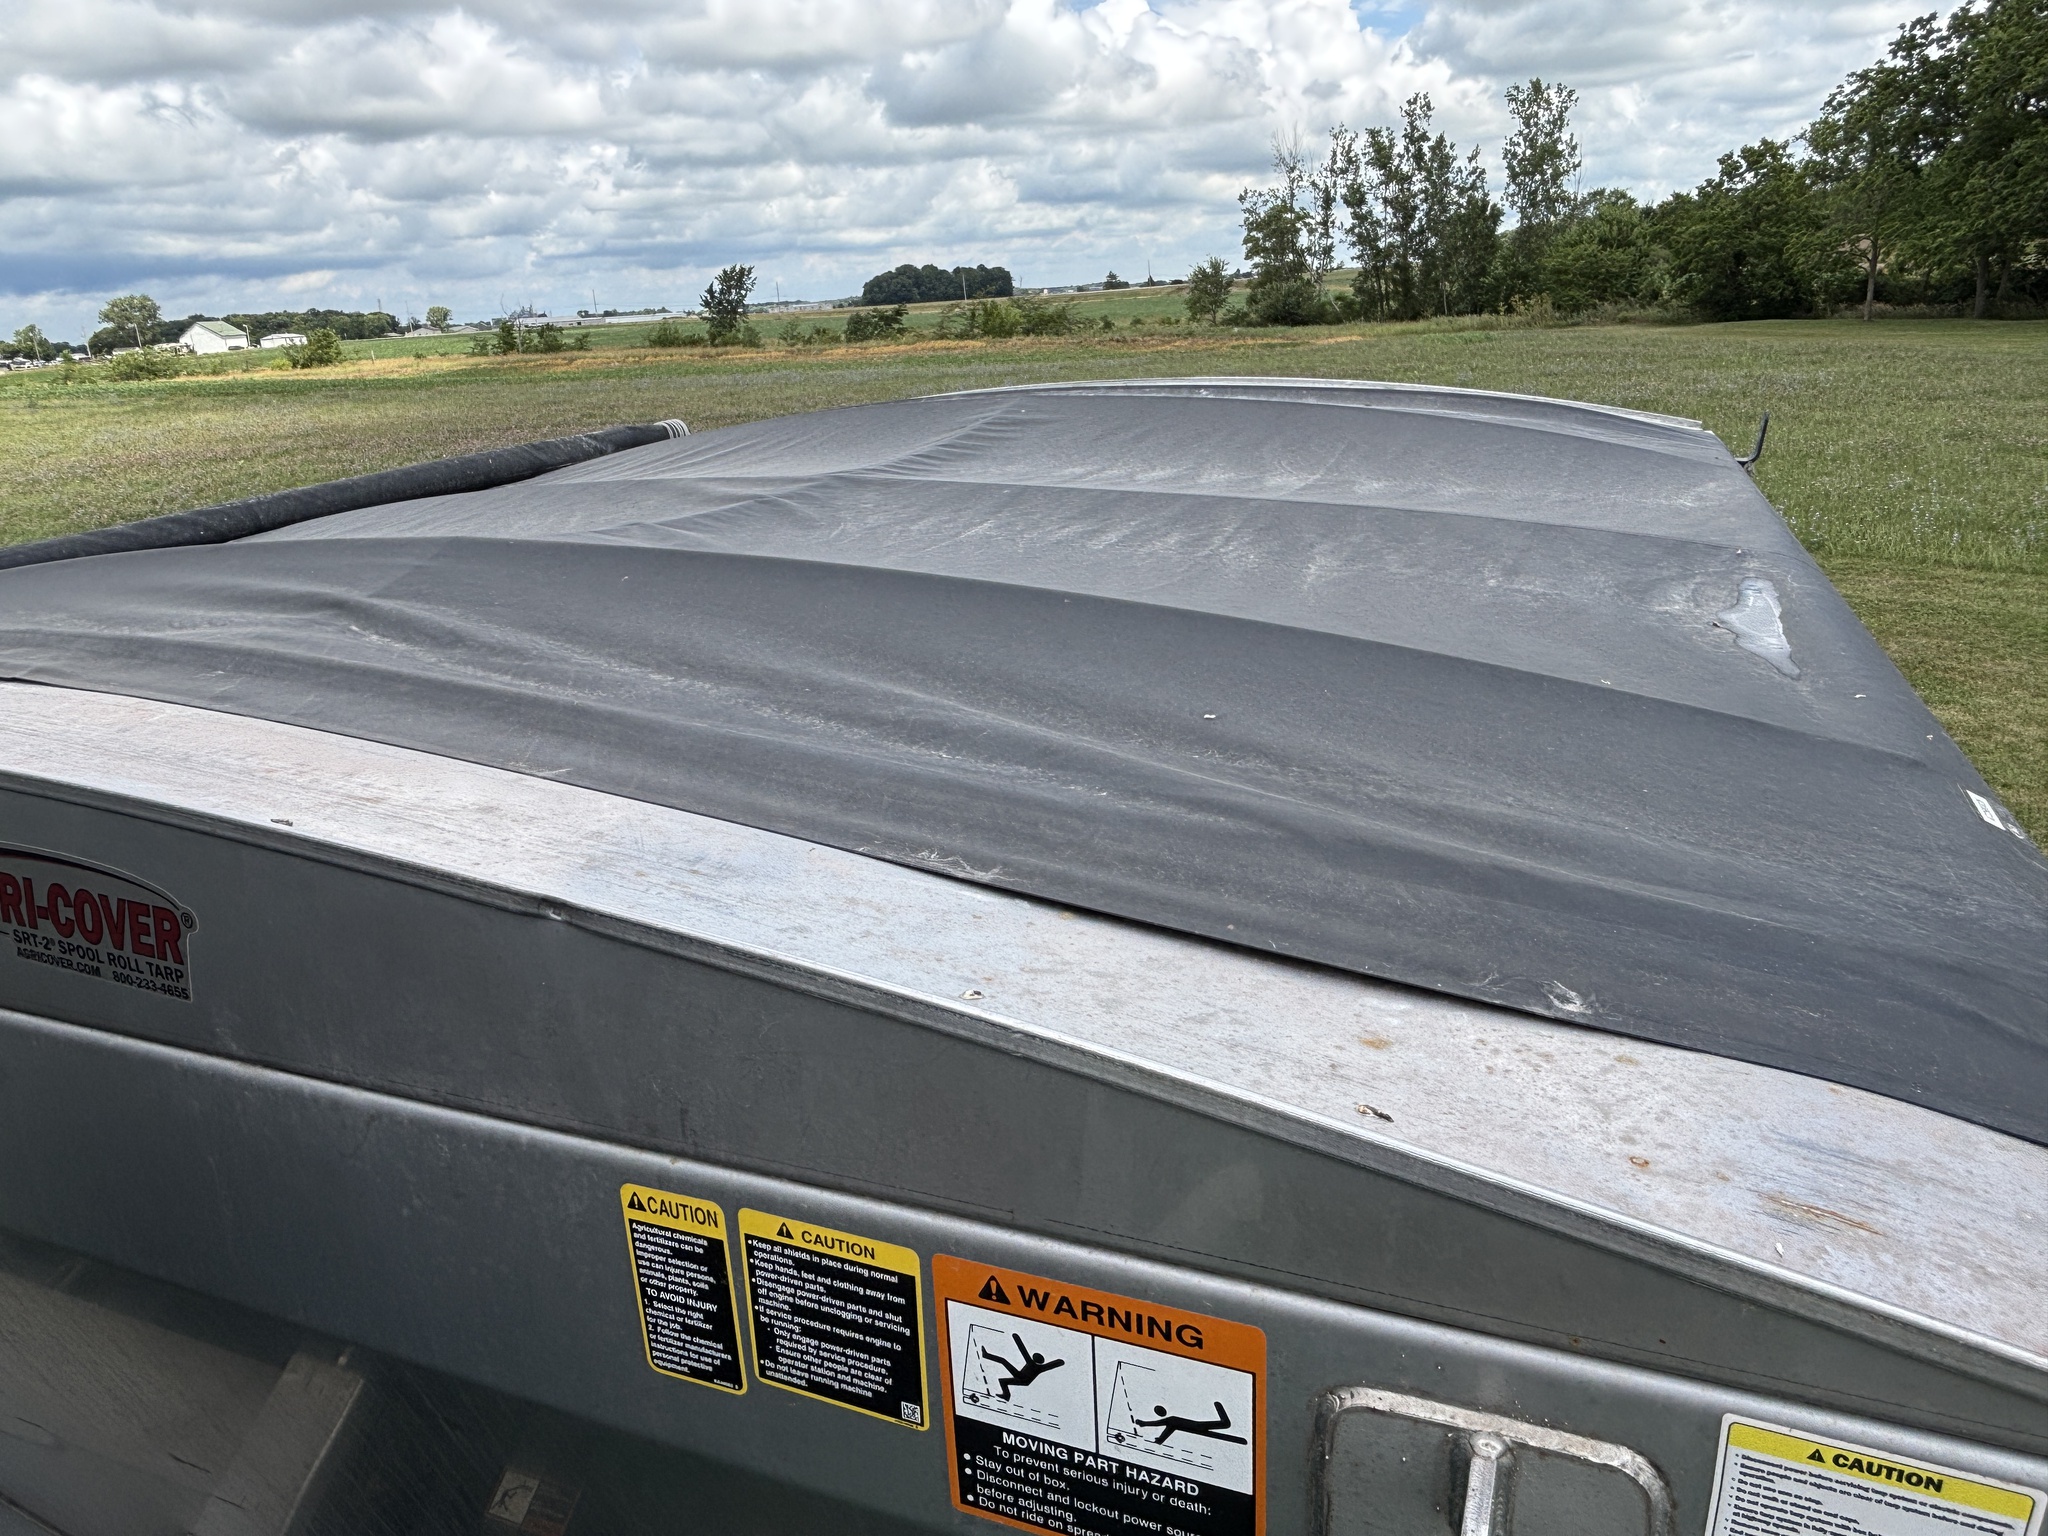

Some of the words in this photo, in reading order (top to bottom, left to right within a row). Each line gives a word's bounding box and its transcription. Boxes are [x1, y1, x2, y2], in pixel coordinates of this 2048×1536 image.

[17, 946, 101, 977] AGRICOVER.COM
[113, 971, 190, 1001] 800-233-4655
[58, 940, 104, 964] SPOOL
[107, 952, 144, 975] ROLL
[145, 962, 184, 984] TARP
[647, 1196, 718, 1228] CAUTION
[632, 1222, 672, 1237] Agricultural
[672, 1232, 708, 1246] chemicals
[633, 1232, 646, 1240] and
[680, 1243, 693, 1251] can
[694, 1245, 704, 1254] be
[634, 1240, 673, 1255] dangerous.
[801, 1230, 875, 1260] CAUTION
[635, 1248, 666, 1262] Improper
[667, 1257, 699, 1270] selection
[637, 1259, 650, 1267] use
[651, 1262, 664, 1270] can
[664, 1264, 685, 1275] injure
[685, 1270, 716, 1284] persons,
[752, 1239, 772, 1251] Keep
[772, 1245, 782, 1253] all
[783, 1247, 811, 1261] shields
[812, 1254, 820, 1263] in
[821, 1258, 842, 1269] place
[843, 1263, 869, 1277] during
[870, 1270, 898, 1283] normal
[753, 1250, 795, 1266] operations.
[639, 1267, 667, 1280] animals,
[667, 1274, 691, 1286] plants,
[692, 1280, 709, 1290] soils
[648, 1278, 666, 1288] other
[667, 1283, 698, 1296] property.
[754, 1258, 773, 1271] Keep
[774, 1263, 800, 1277] hands,
[801, 1270, 815, 1281] feet
[816, 1275, 831, 1285] and
[832, 1279, 864, 1295] clothing
[865, 1288, 885, 1300] away
[886, 1292, 905, 1304] from
[755, 1269, 803, 1286] power-driven
[804, 1282, 826, 1293] parts.
[645, 1287, 658, 1297] TO
[659, 1291, 685, 1304] AVOID
[686, 1297, 717, 1312] INJURY
[652, 1300, 674, 1312] Select
[674, 1306, 686, 1315] the
[687, 1310, 704, 1320] right
[756, 1277, 795, 1294] Disengage
[796, 1289, 845, 1307] power-driven
[846, 1302, 867, 1313] parts
[868, 1308, 883, 1318] and
[884, 1312, 902, 1323] shut
[757, 1287, 767, 1295] off
[768, 1291, 794, 1303] engine
[794, 1296, 819, 1310] before
[820, 1305, 863, 1323] unclogging
[864, 1316, 873, 1324] or
[874, 1319, 910, 1336] servicing
[758, 1297, 791, 1311] machine.
[645, 1307, 675, 1320] chemical
[684, 1317, 713, 1330] fertilizer
[646, 1315, 656, 1323] for
[656, 1318, 668, 1327] the
[669, 1321, 682, 1330] job.
[758, 1304, 764, 1312] If
[765, 1308, 792, 1320] service
[793, 1316, 831, 1331] procedure
[832, 1326, 864, 1340] requires
[865, 1335, 892, 1348] engine
[893, 1342, 902, 1351] to
[759, 1314, 770, 1323] be
[770, 1318, 801, 1332] running:
[1017, 1285, 1204, 1350] WARNING
[647, 1323, 654, 1331] 2.
[656, 1326, 679, 1338] Follow
[679, 1332, 692, 1341] the
[692, 1336, 723, 1350] chemical
[657, 1334, 683, 1347] fertilizer
[773, 1327, 791, 1339] Only
[791, 1333, 819, 1346] engage
[820, 1341, 869, 1360] power-driven
[870, 1356, 891, 1367] parts
[650, 1341, 688, 1357] instructions
[689, 1351, 699, 1359] for
[699, 1355, 712, 1363] use
[713, 1358, 720, 1366] of
[651, 1350, 680, 1362] personal
[680, 1358, 713, 1372] protective
[775, 1345, 801, 1359] Ensure
[802, 1354, 822, 1364] other
[823, 1360, 849, 1372] people
[850, 1368, 862, 1377] are
[863, 1372, 882, 1382] clear
[884, 1377, 892, 1385] of
[776, 1338, 807, 1351] required
[807, 1345, 817, 1356] by
[818, 1350, 846, 1363] service
[847, 1358, 888, 1375] procedure.
[764, 1359, 775, 1368] Do
[776, 1364, 789, 1373] not
[789, 1366, 809, 1378] leave
[810, 1374, 839, 1389] running
[840, 1383, 872, 1397] machine
[765, 1370, 808, 1387] unattended.
[777, 1356, 808, 1369] operator
[810, 1365, 836, 1377] station
[836, 1373, 851, 1382] and
[852, 1377, 887, 1393] machine.
[975, 1455, 1002, 1473] Stay
[1006, 1465, 1025, 1478] out
[1028, 1472, 1041, 1481] of
[1044, 1474, 1070, 1490] box.
[1003, 1432, 1068, 1461] MOVING
[1074, 1452, 1119, 1474] PART
[1126, 1466, 1199, 1496] HAZARD
[1832, 1453, 1943, 1493] CAUTION
[993, 1446, 1009, 1458] To
[1014, 1453, 1059, 1473] prevent
[1063, 1468, 1109, 1487] serious
[1112, 1479, 1149, 1499] injury
[1152, 1494, 1165, 1503] or
[1170, 1496, 1211, 1516] death:
[977, 1470, 1043, 1497] Disconnect
[1047, 1492, 1070, 1505] and
[1074, 1498, 1119, 1520] lockout
[1123, 1514, 1162, 1531] power
[977, 1484, 1014, 1502] before
[1018, 1498, 1077, 1522] adjusting.
[979, 1496, 995, 1509] Do
[999, 1504, 1018, 1516] not
[1022, 1509, 1044, 1524] ride
[1048, 1519, 1063, 1530] on
